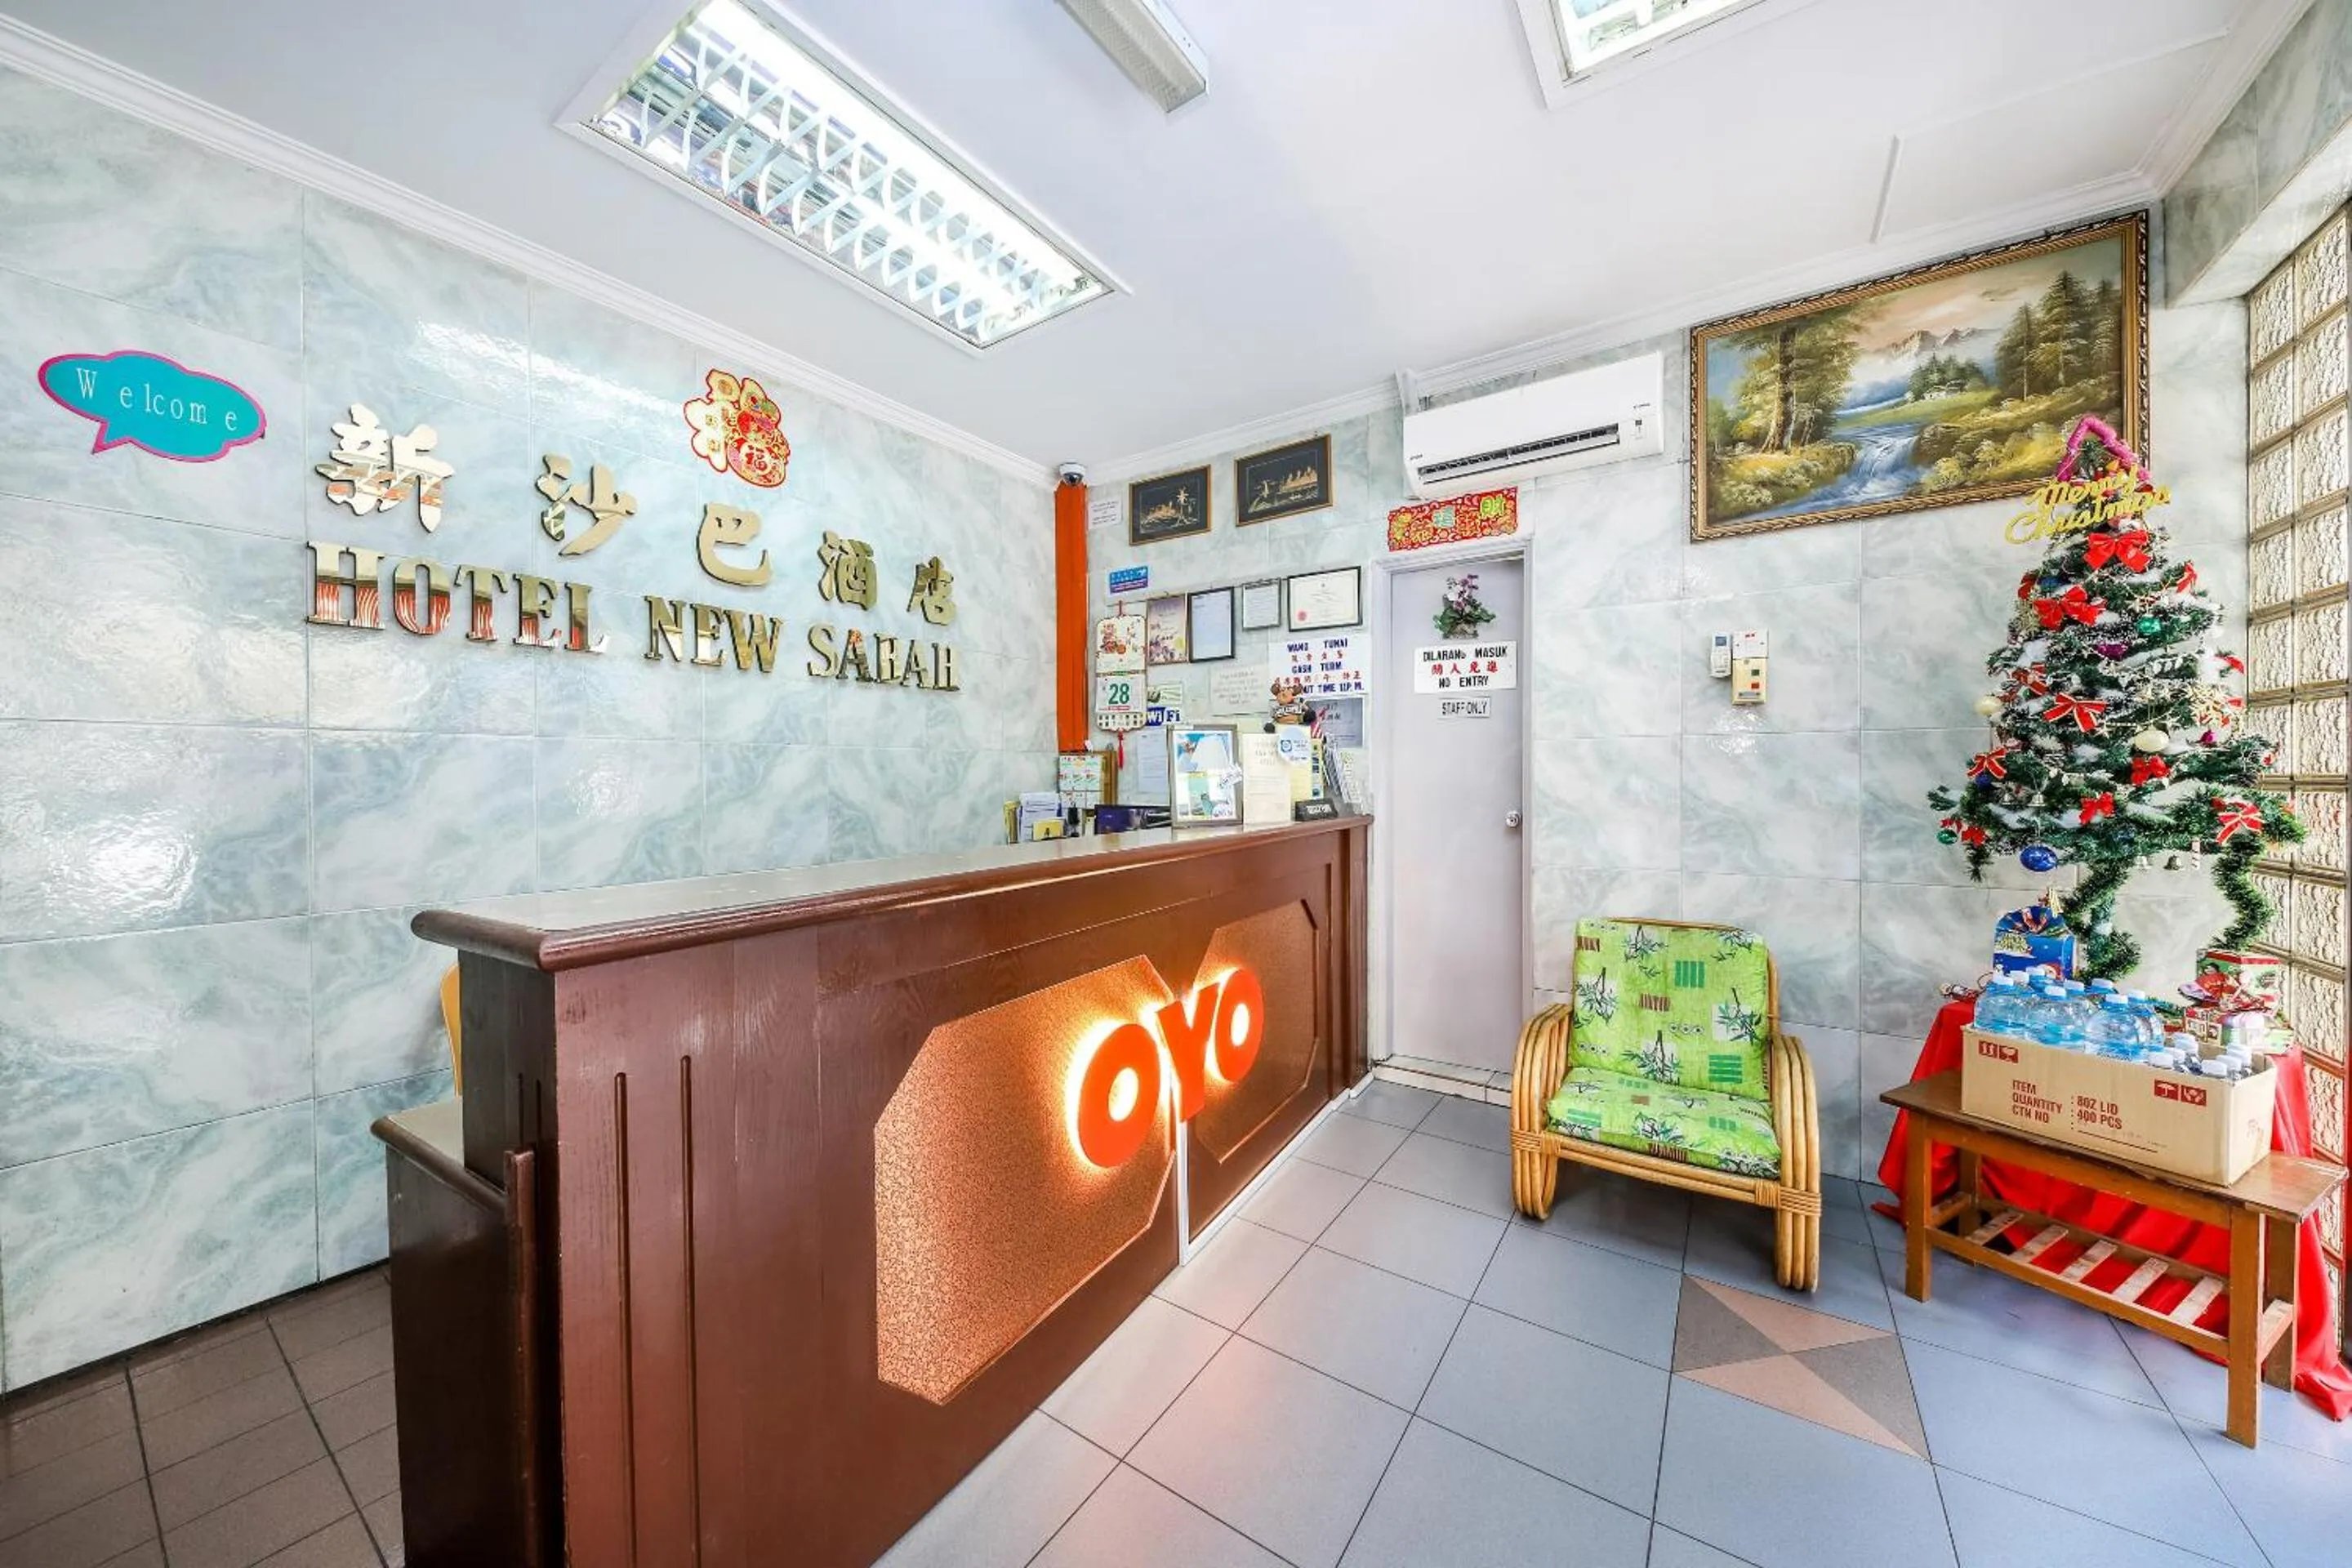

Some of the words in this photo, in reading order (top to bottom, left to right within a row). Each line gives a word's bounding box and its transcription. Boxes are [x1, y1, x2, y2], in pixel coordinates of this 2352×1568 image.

[77, 368, 238, 432] Welcome
[306, 540, 611, 654] HOTEL
[644, 595, 786, 674] NEW
[807, 623, 960, 691] SABAH
[1476, 646, 1508, 657] MASUK
[1439, 677, 1450, 688] NO
[1459, 675, 1489, 688] ENTRY
[1108, 683, 1130, 705] 28
[1442, 702, 1465, 715] STAFF
[1467, 700, 1487, 715] ONLY
[1077, 969, 1263, 1169] OYO
[2012, 1079, 2037, 1095] ITEM
[2012, 1092, 2062, 1114] QUANTITY
[2100, 1102, 2118, 1116] LID
[2011, 1104, 2032, 1119] CTN
[2034, 1111, 2049, 1124] NO
[2100, 1114, 2123, 1129] PCS
